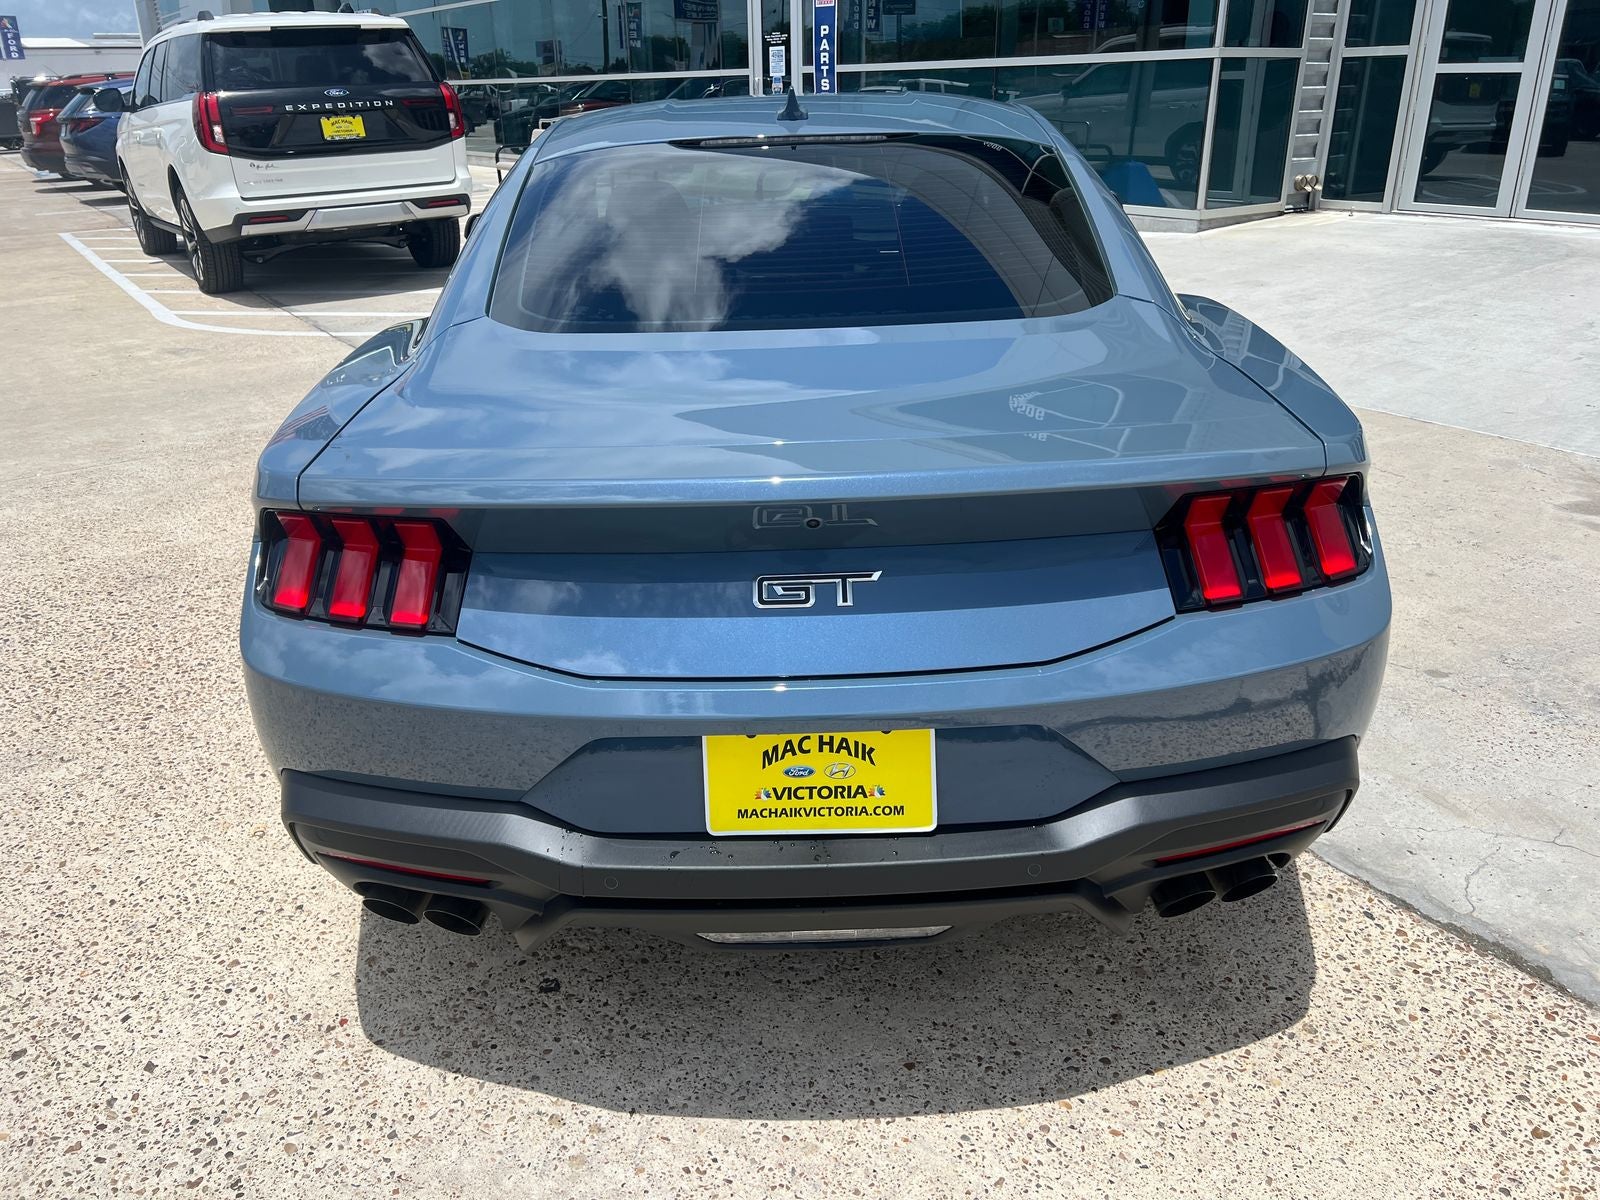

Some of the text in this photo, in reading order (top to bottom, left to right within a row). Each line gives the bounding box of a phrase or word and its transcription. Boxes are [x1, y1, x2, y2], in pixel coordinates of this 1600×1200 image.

[820, 25, 830, 91] PARTS
[285, 100, 394, 111] EXPEDITION
[752, 570, 883, 609] GT
[762, 735, 876, 769] MAC HAIK
[772, 785, 868, 801] VICTORIA
[737, 805, 905, 819] MACHAIKVICTORIA.COM
